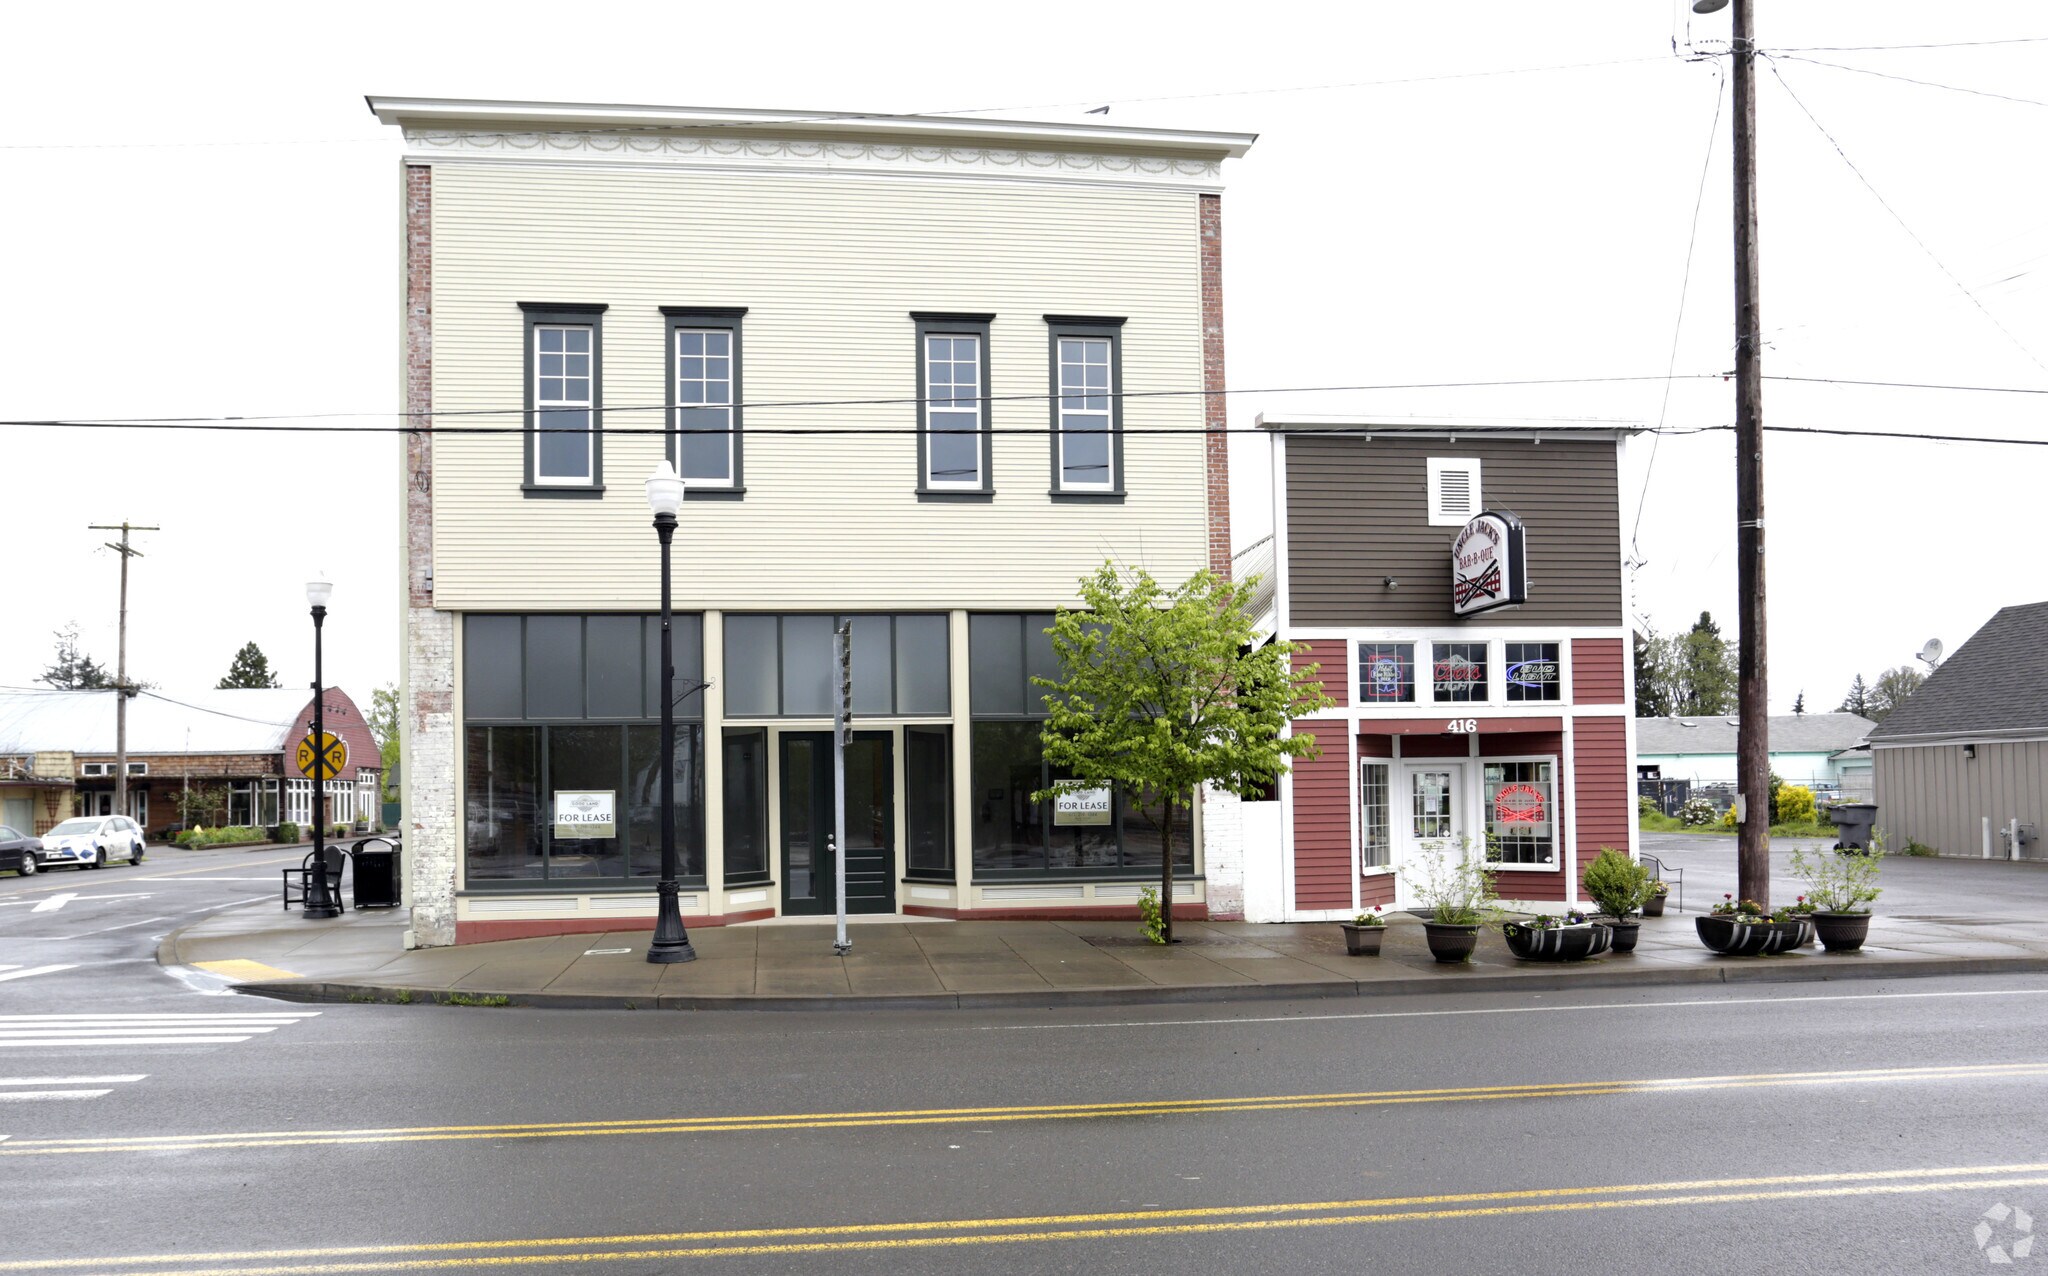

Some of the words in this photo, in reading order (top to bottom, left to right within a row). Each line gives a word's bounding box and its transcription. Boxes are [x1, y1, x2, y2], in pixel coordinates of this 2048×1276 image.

[1454, 522, 1475, 559] UNCLE
[1476, 520, 1500, 546] JACK'S
[1432, 659, 1482, 681] Coors
[1434, 681, 1475, 691] LIGHT
[1447, 719, 1477, 733] 416
[300, 749, 309, 762] R
[332, 750, 342, 763] R
[1059, 802, 1078, 810] FOR
[1080, 802, 1108, 810] LEASE
[559, 813, 579, 822] FOR
[582, 813, 612, 822] LEASE
